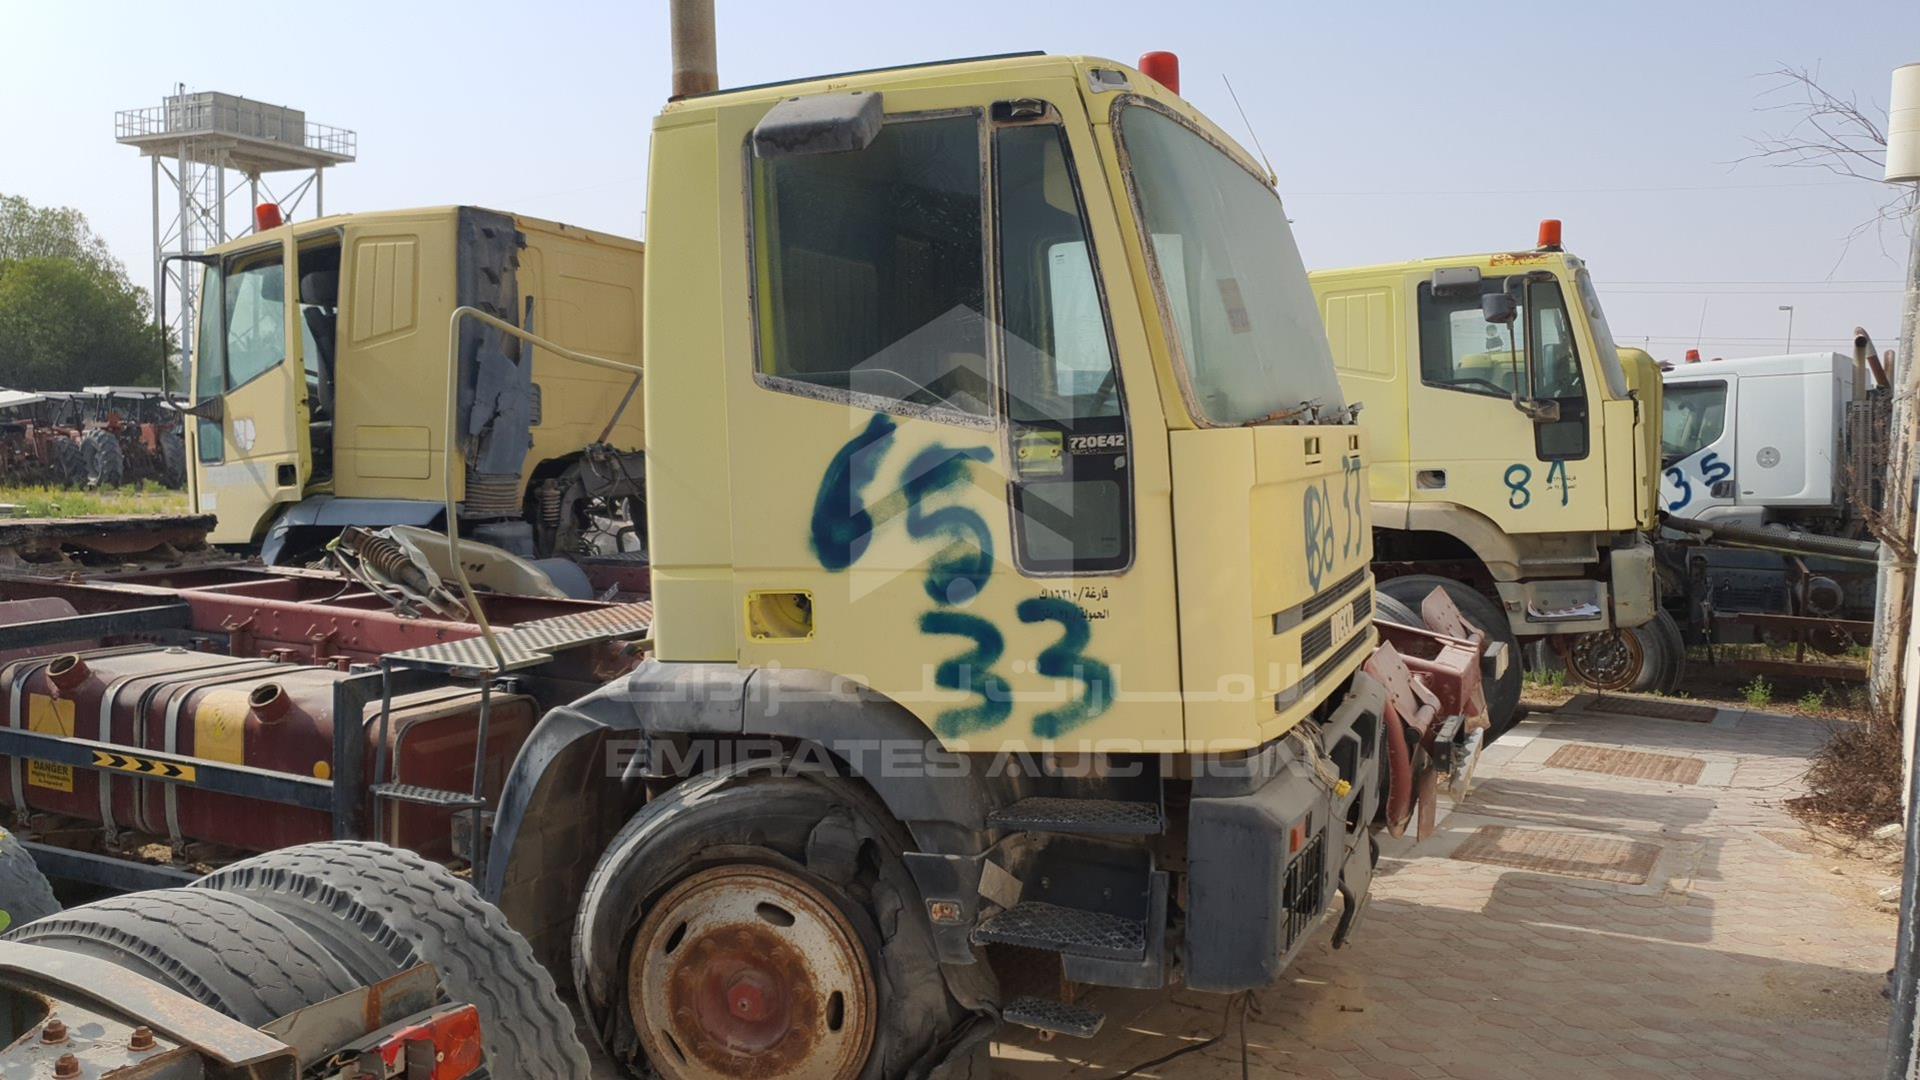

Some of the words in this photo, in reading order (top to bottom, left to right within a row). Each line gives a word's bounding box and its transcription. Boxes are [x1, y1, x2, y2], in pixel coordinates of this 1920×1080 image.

[1070, 435, 1124, 449] 720E42
[811, 411, 994, 605] 65
[1666, 452, 1731, 511] 35
[920, 600, 1116, 740] 33
[33, 760, 68, 776] DANGER
